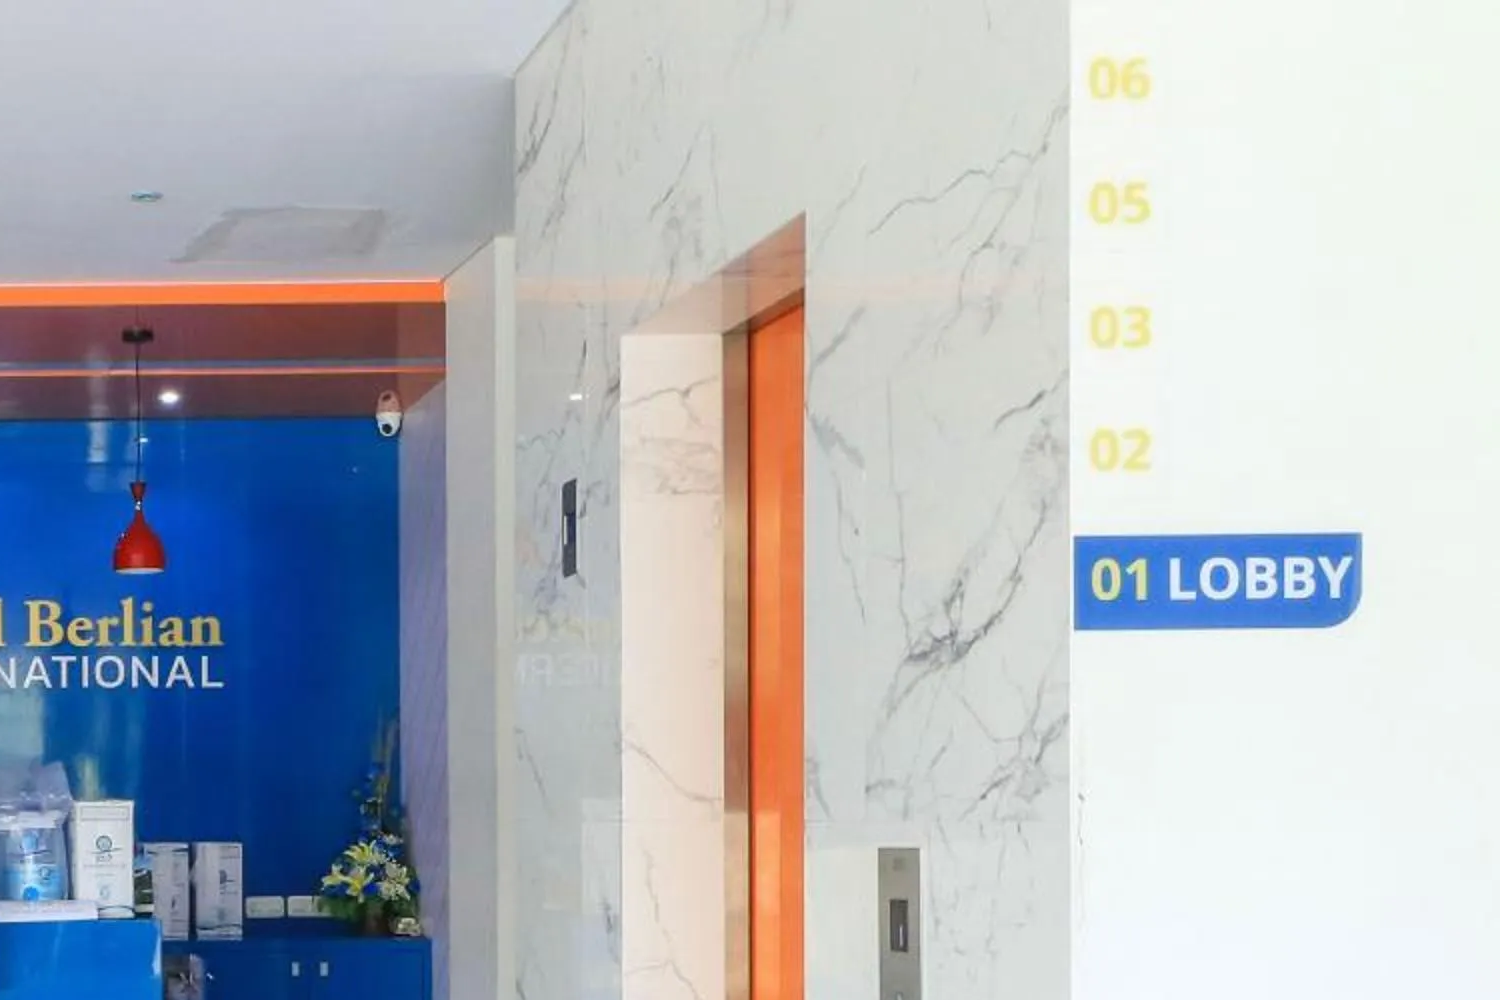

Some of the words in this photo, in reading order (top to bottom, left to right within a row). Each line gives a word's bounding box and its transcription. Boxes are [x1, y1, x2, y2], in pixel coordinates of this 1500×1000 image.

[1087, 55, 1152, 101] 06
[1087, 180, 1153, 226] 05
[1088, 305, 1153, 350] 03
[1088, 427, 1153, 473] 02
[1090, 557, 1150, 602] 01
[1168, 556, 1353, 602] LOBBY
[24, 597, 224, 648] Berlian
